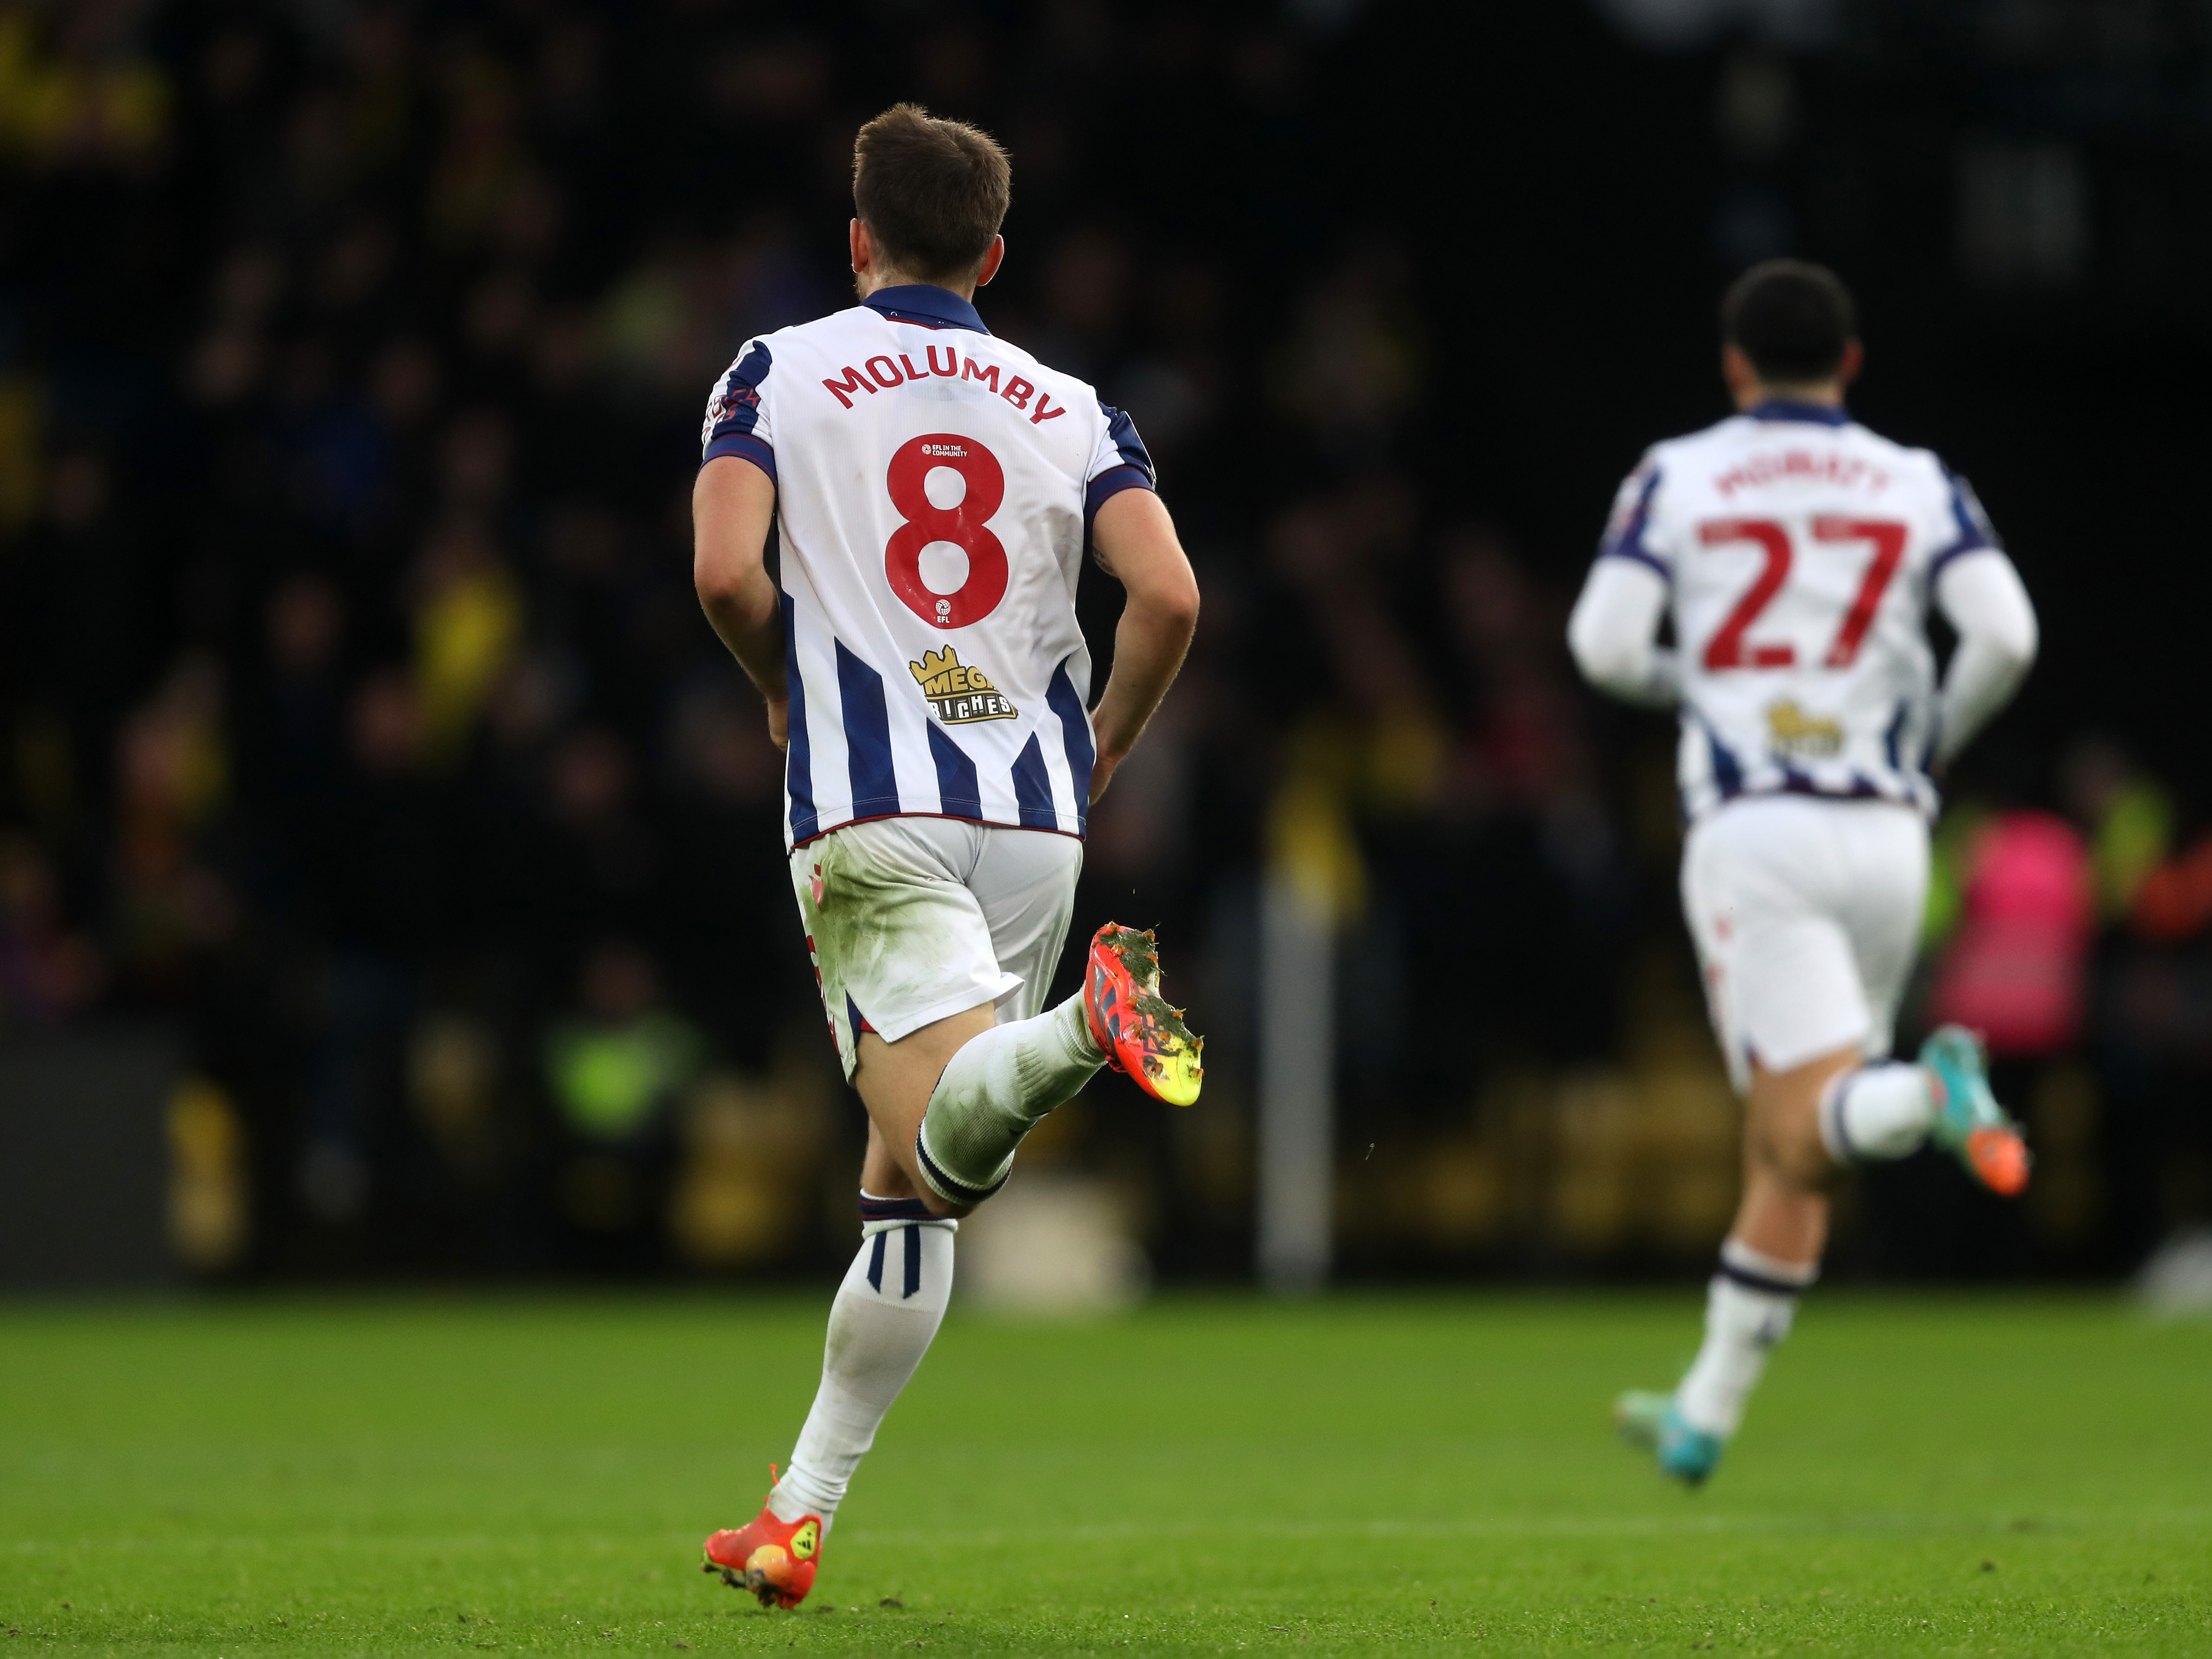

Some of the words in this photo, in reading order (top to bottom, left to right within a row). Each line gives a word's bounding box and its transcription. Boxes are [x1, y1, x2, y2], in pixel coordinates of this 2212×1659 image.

[822, 346, 1066, 424] MOLUMBY
[885, 433, 1008, 629] 8
[1698, 515, 1909, 672] 27
[924, 667, 993, 695] MEG
[928, 695, 1011, 718] RICHES
